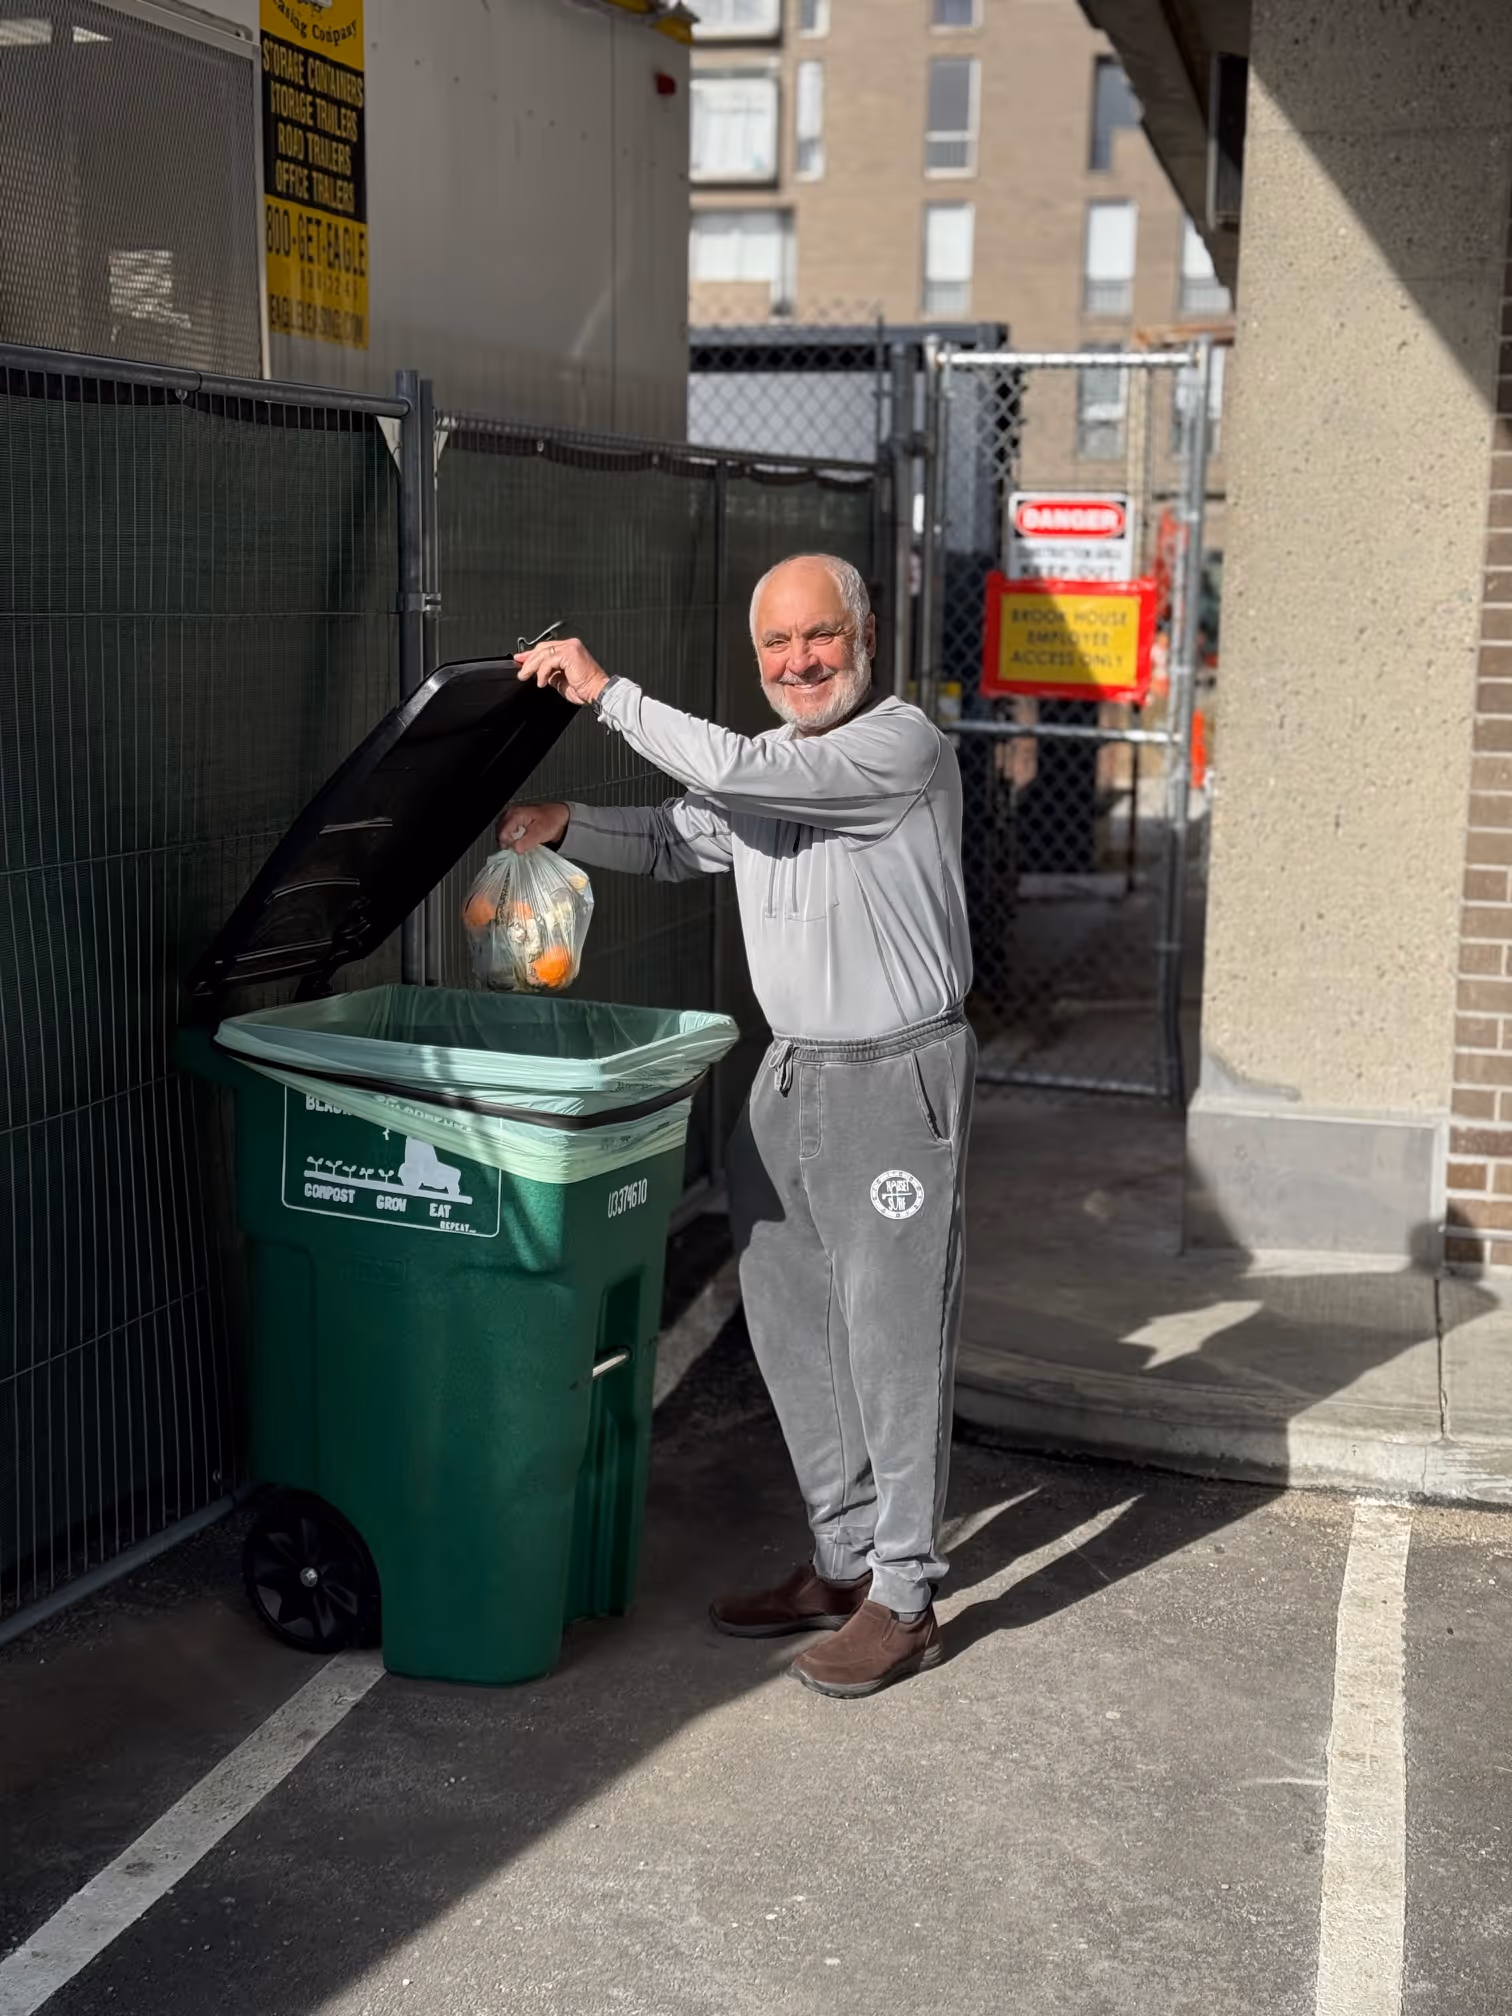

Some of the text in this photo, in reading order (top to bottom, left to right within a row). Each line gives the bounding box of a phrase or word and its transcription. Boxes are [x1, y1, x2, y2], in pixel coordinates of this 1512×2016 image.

[310, 19, 356, 46] Company
[262, 38, 363, 107] STORAGE CONTAINERS
[271, 79, 358, 142] STORAGE TRAILERS
[277, 122, 351, 176] ROAD TRAILERS
[275, 159, 354, 212] OFFICE TRAILERS
[1022, 508, 1118, 531] DANGER
[1074, 610, 1127, 626] HOUSE
[1027, 630, 1110, 646] EMPLOYEE
[1011, 650, 1074, 666] ACCESS
[304, 1183, 452, 1219] COMPOST GROW EAT
